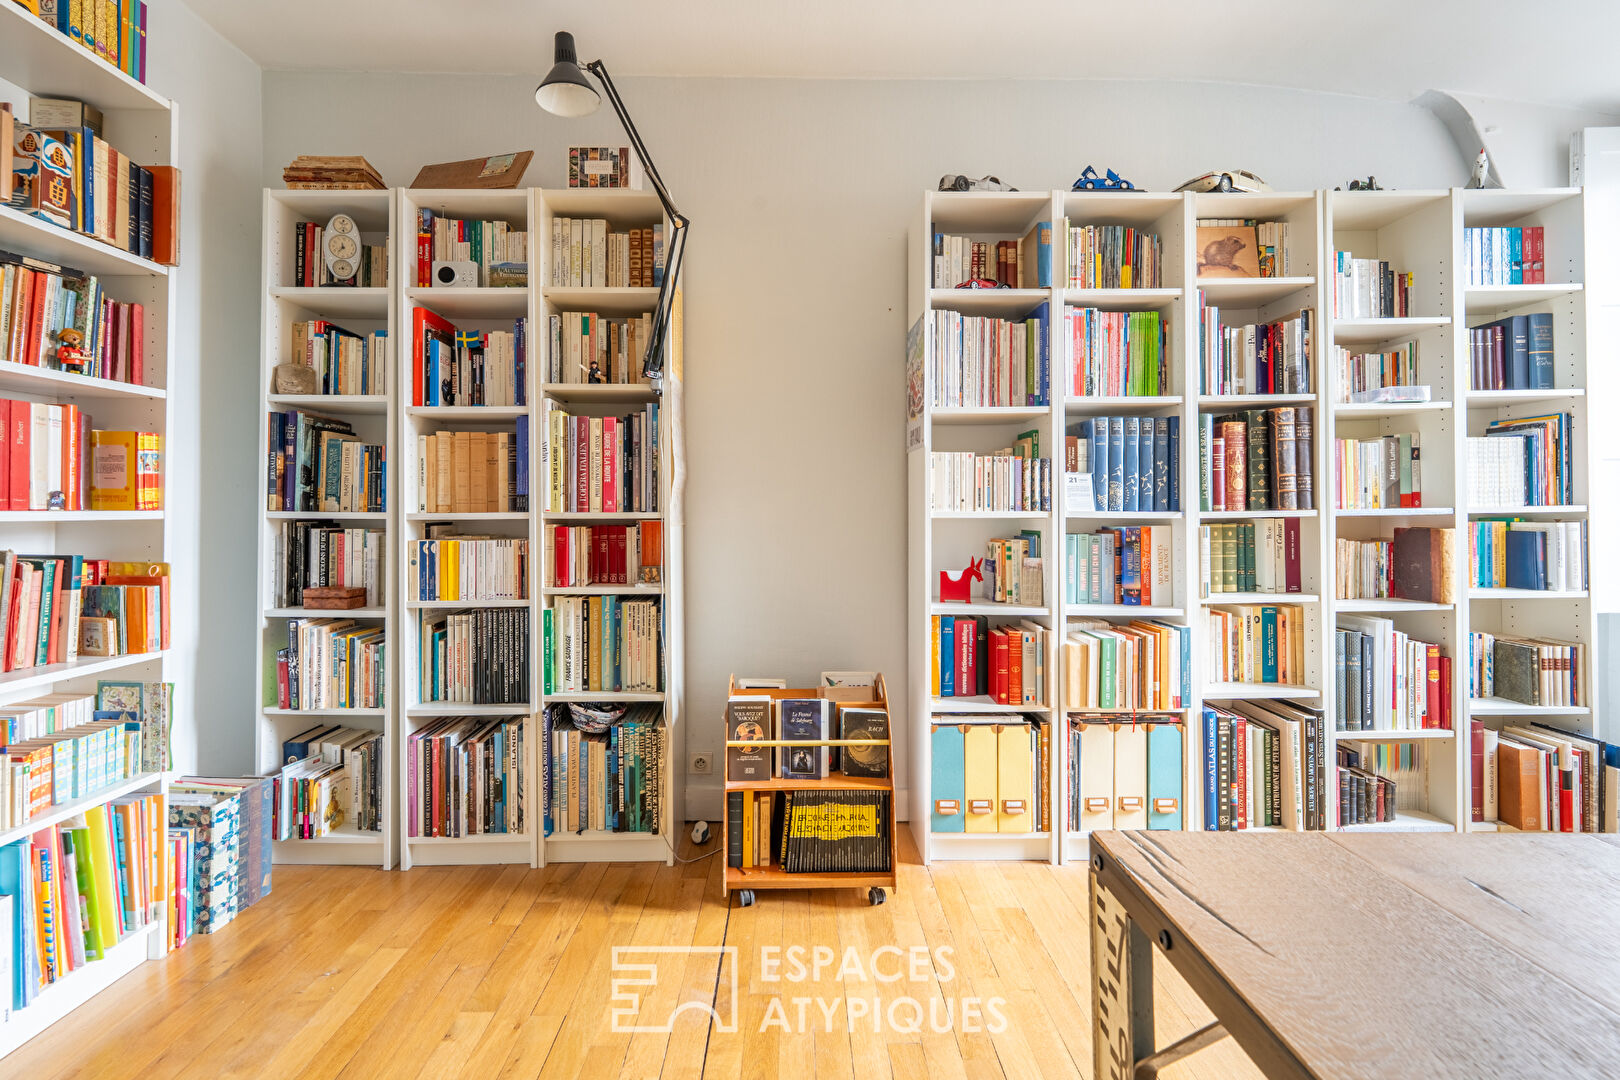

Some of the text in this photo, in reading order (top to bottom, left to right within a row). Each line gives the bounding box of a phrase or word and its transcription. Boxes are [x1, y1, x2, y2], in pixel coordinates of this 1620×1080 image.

[16, 421, 24, 445] Flaubert
[342, 446, 351, 496] MARTIN LUTHER
[579, 442, 587, 502] L'OPÉRA ITALIEN
[320, 542, 326, 551] DU
[1209, 738, 1214, 747] DU
[1273, 763, 1280, 772] DE
[645, 770, 652, 780] DE
[1308, 776, 1315, 784] AU
[652, 796, 658, 804] DE
[1273, 809, 1280, 818] LE
